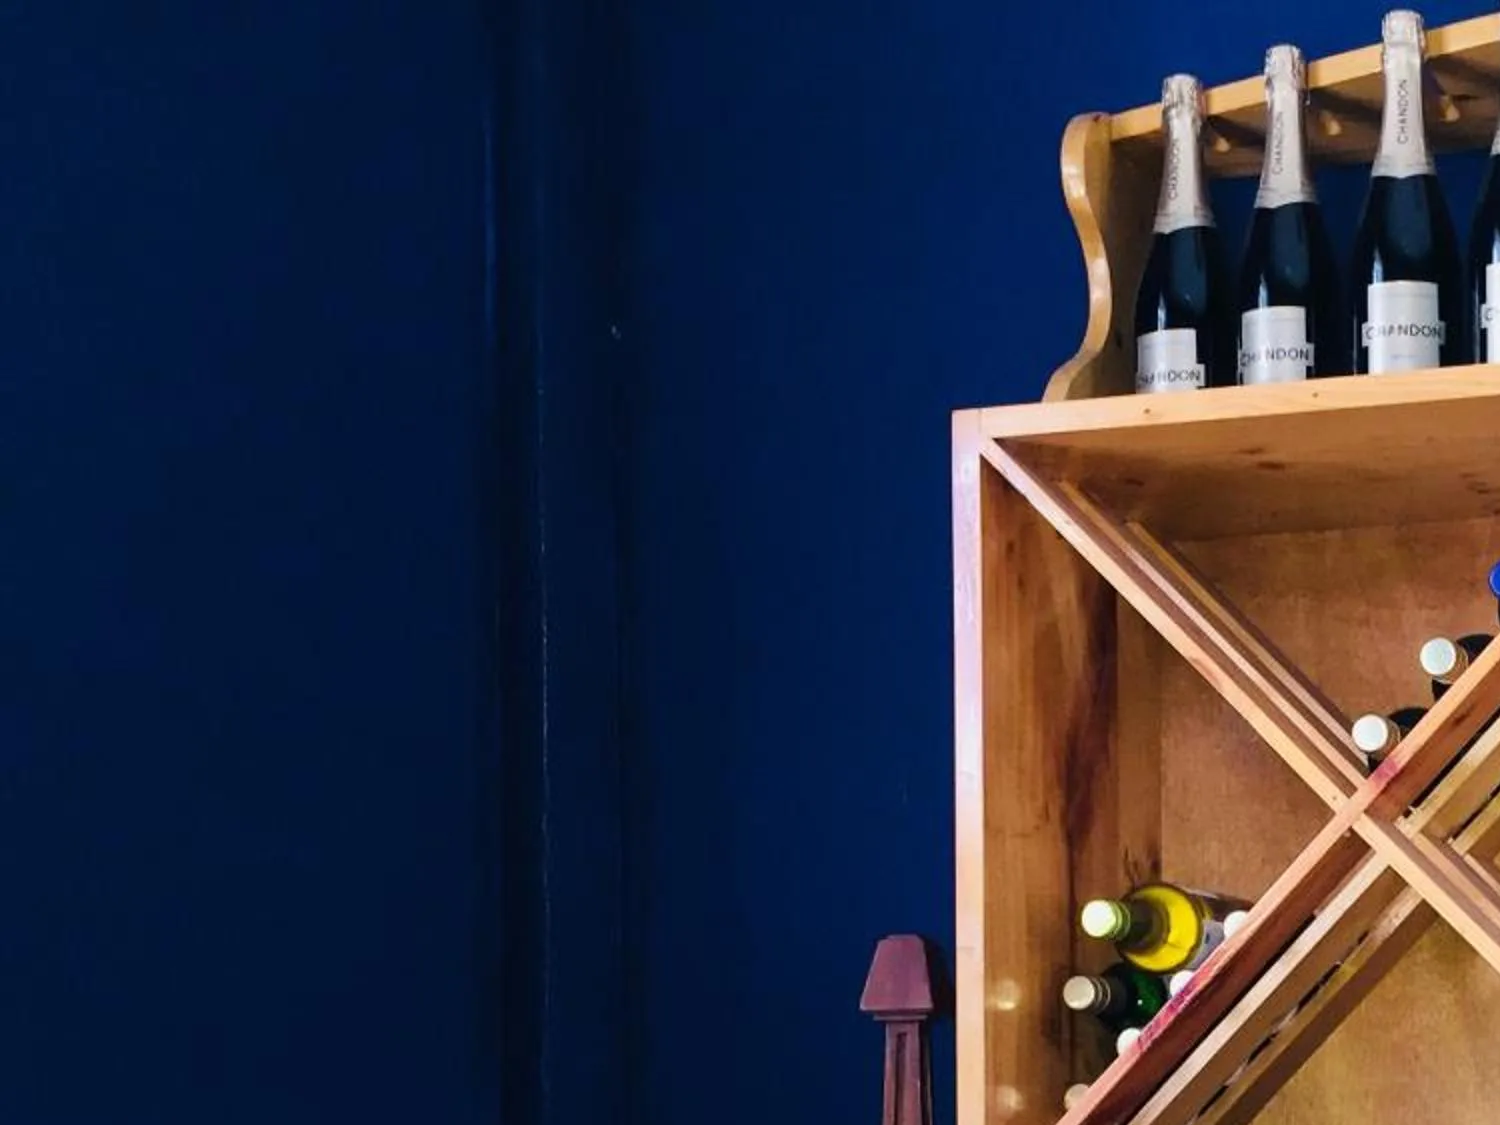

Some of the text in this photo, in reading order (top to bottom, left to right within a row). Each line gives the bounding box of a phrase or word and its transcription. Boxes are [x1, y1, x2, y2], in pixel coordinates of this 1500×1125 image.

[1397, 78, 1409, 145] CHANDON
[1272, 111, 1285, 176] CHANDON
[1364, 322, 1442, 341] CHANDON
[1239, 346, 1309, 368] CHNDON
